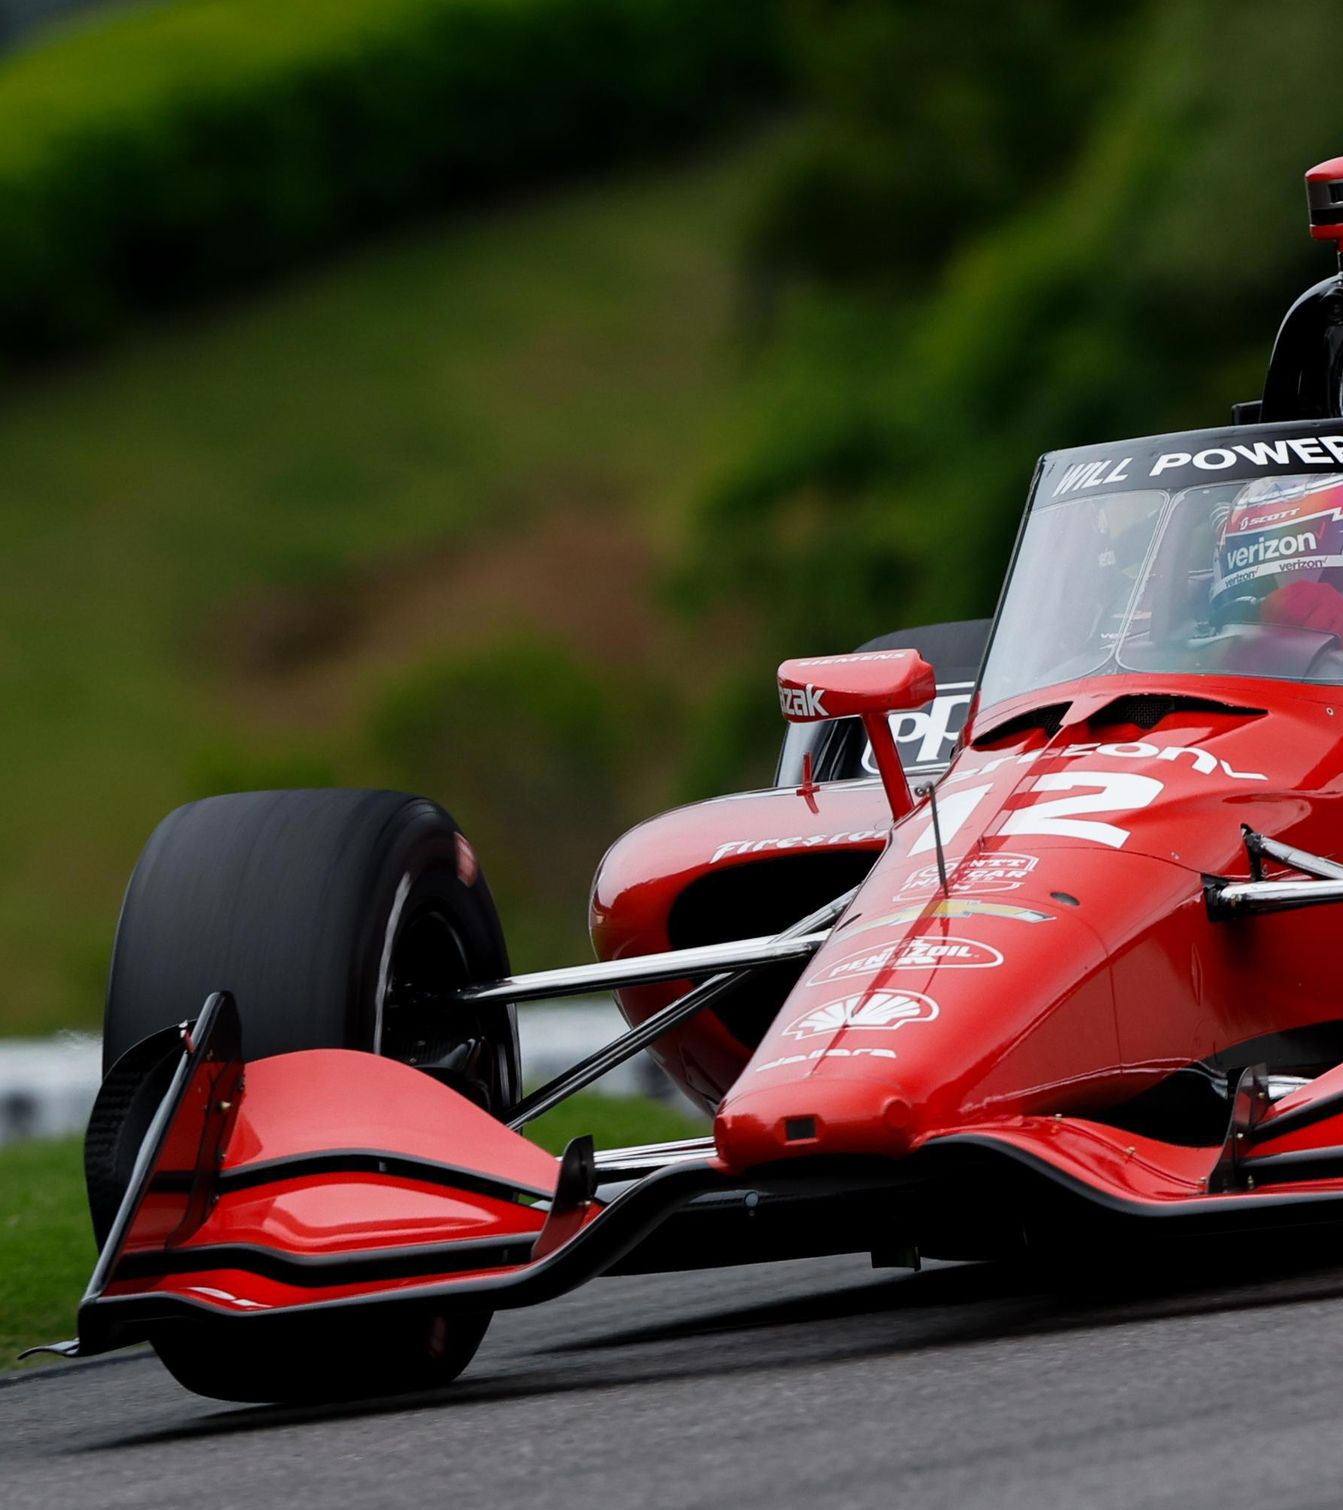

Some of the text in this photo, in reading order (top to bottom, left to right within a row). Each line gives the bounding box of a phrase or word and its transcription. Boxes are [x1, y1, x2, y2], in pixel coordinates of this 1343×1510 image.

[1051, 457, 1134, 498] WILL
[1248, 507, 1300, 526] SCOTT
[1226, 531, 1318, 570] verizon
[1279, 557, 1324, 572] verizon
[798, 652, 907, 667] SIEMENS
[906, 771, 1165, 858] 12
